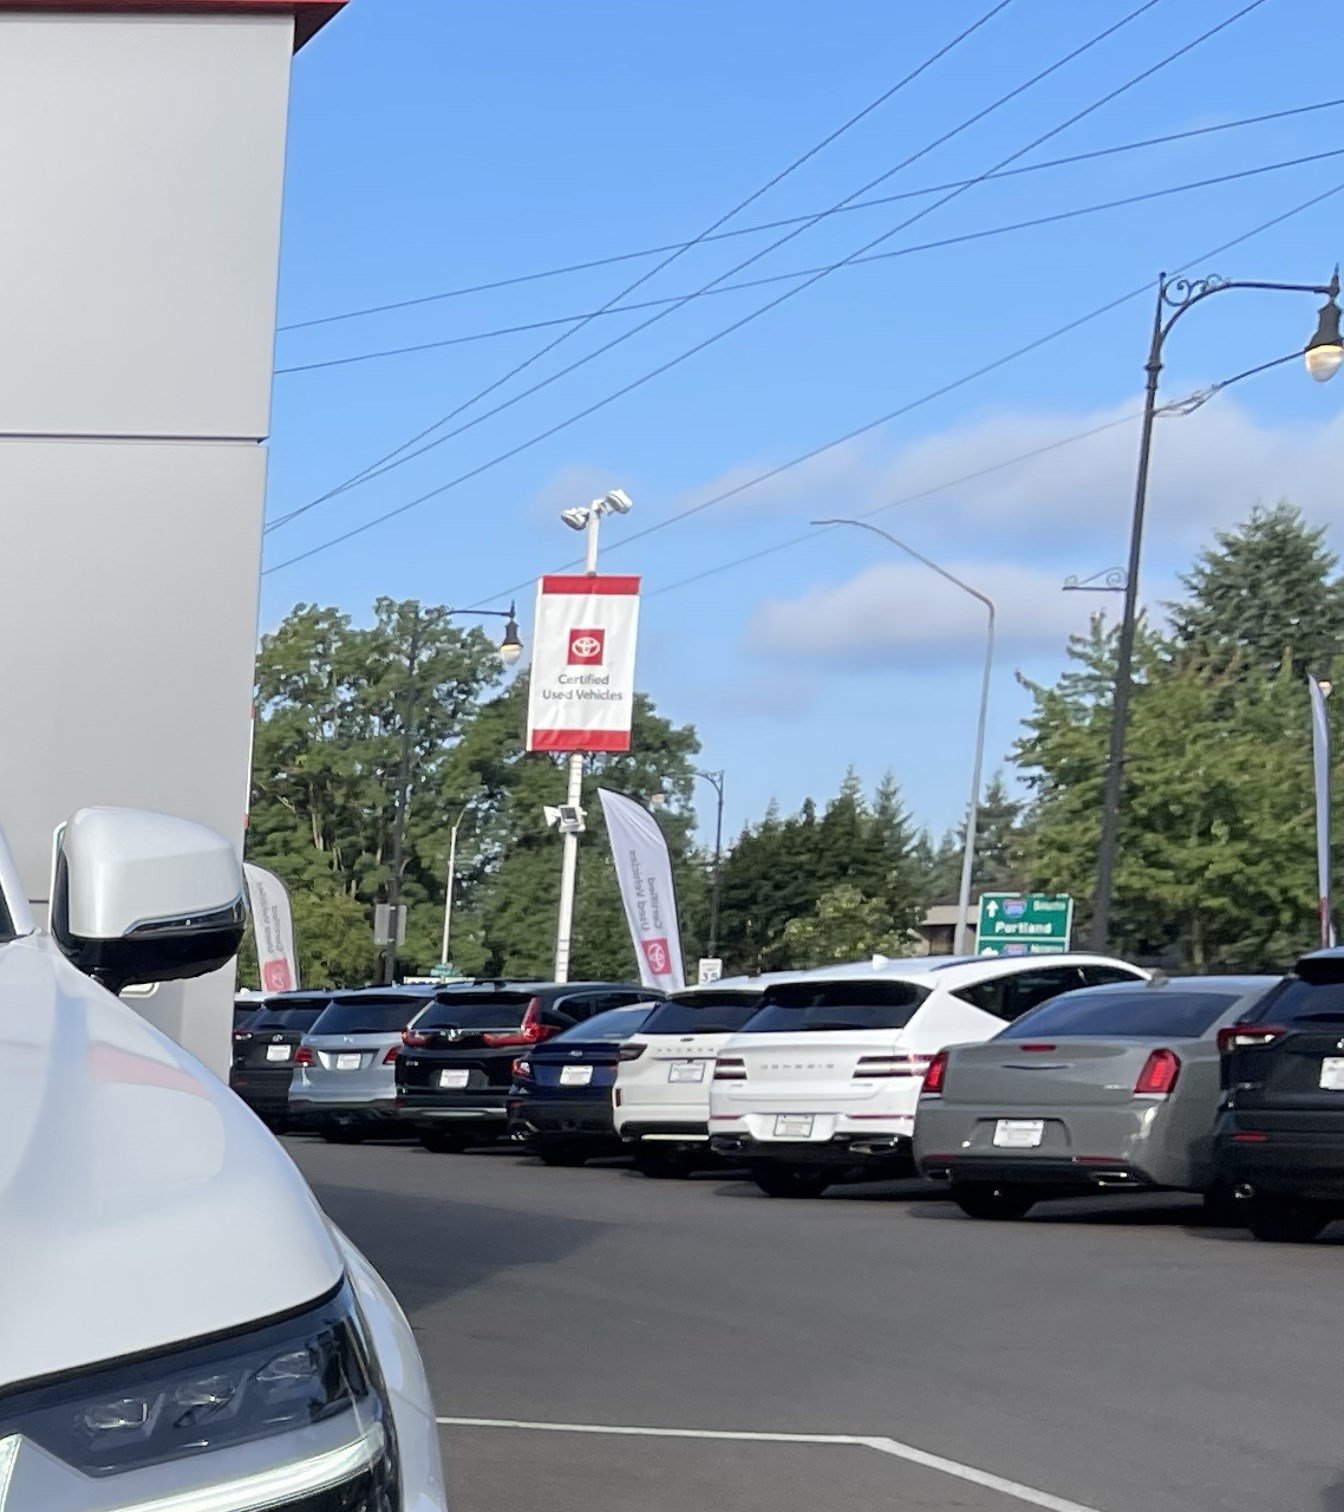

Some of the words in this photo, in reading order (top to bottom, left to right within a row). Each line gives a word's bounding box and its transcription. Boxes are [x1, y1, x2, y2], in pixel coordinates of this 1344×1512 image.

[557, 673, 611, 685] Certified
[542, 689, 573, 700] Used
[575, 689, 624, 701] Vehicles
